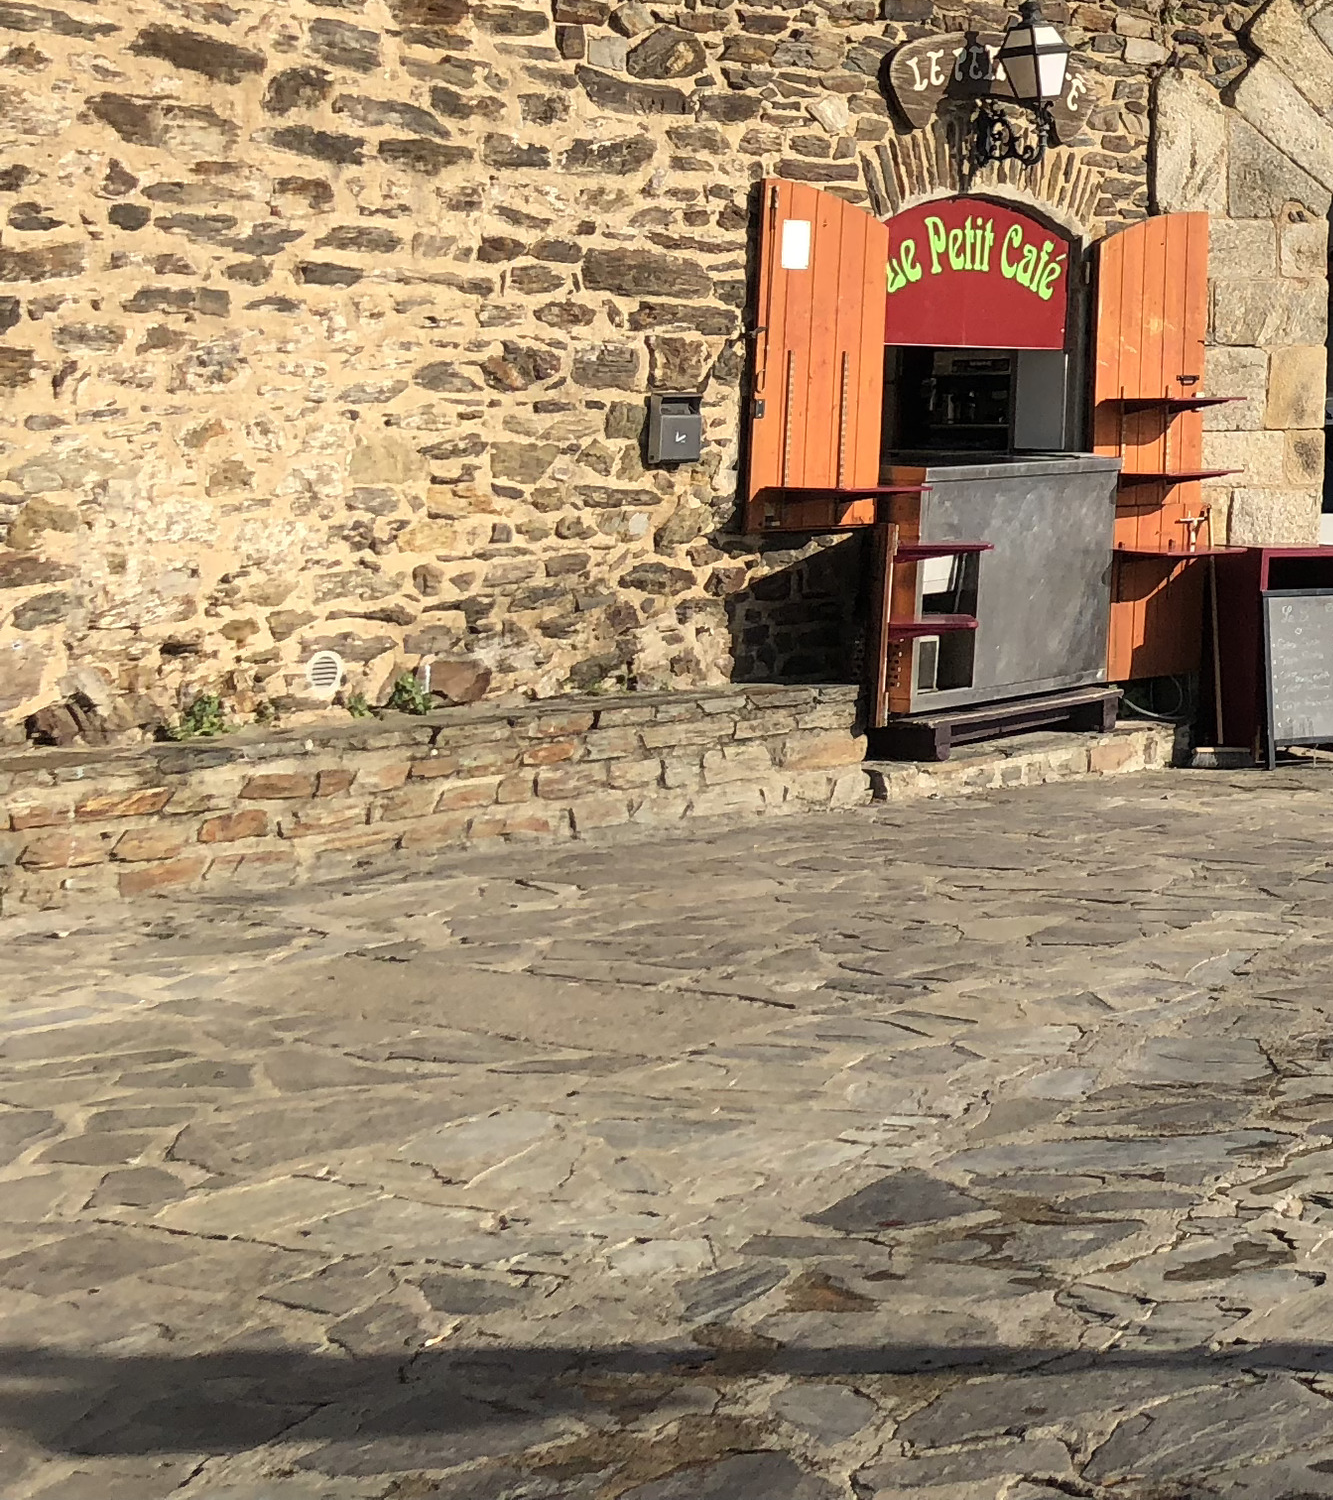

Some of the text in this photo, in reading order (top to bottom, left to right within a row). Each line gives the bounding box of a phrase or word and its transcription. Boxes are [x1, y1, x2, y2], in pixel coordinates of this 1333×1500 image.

[906, 49, 945, 91] LE
[924, 215, 994, 275] Petit
[1001, 224, 1067, 300] Café
